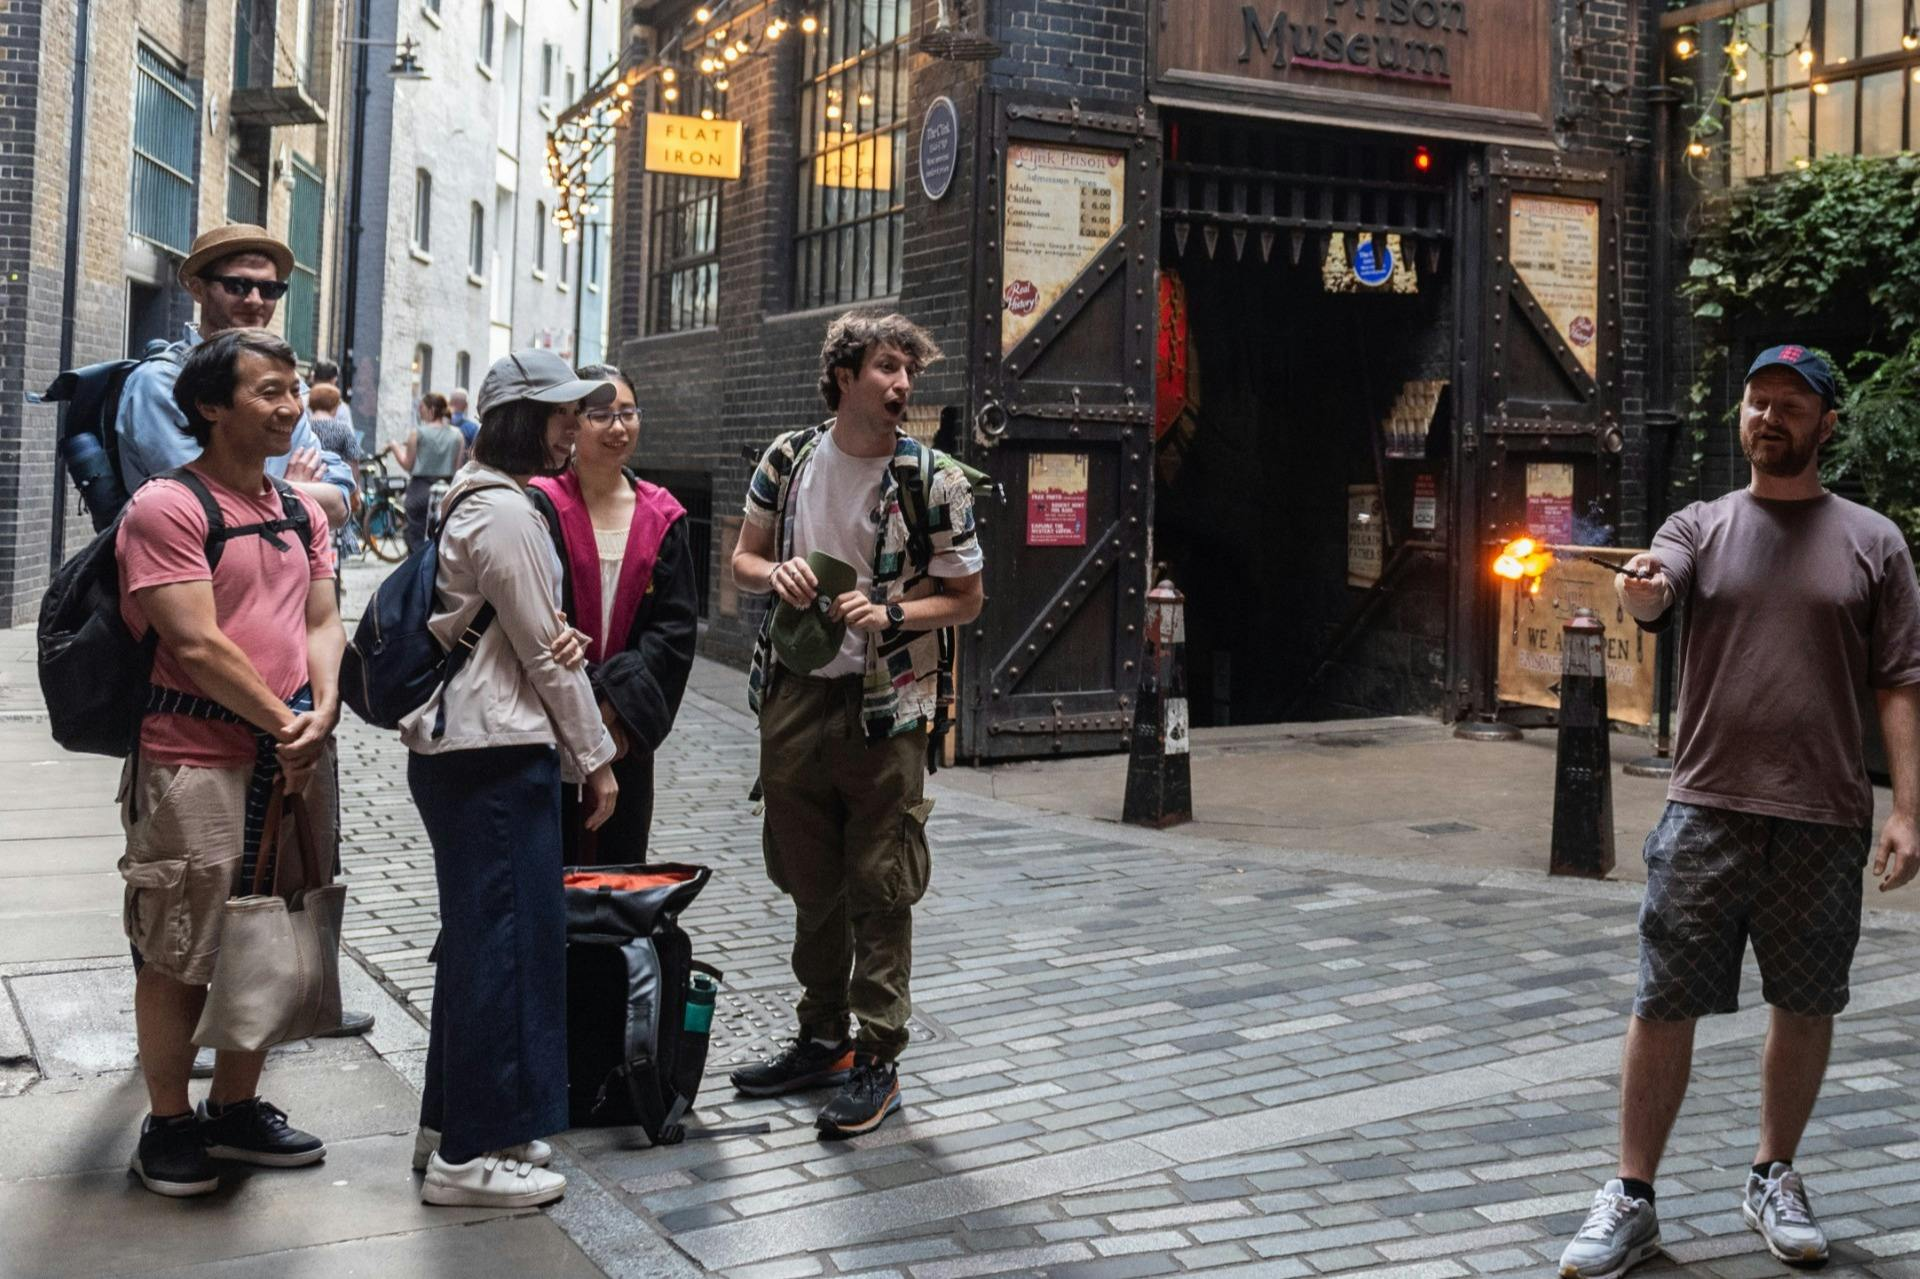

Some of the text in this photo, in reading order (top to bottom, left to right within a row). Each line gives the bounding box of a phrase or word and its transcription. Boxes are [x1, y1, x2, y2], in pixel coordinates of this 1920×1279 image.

[1237, 6, 1450, 77] Museum
[665, 124, 722, 142] FLAT
[664, 149, 721, 166] IRON
[1061, 151, 1105, 169] Prison
[1008, 183, 1032, 193] Adults
[1007, 194, 1042, 206] Children
[1006, 218, 1033, 230] Family
[1010, 280, 1031, 296] Real
[1008, 292, 1040, 313] History!
[1528, 627, 1548, 650] WE
